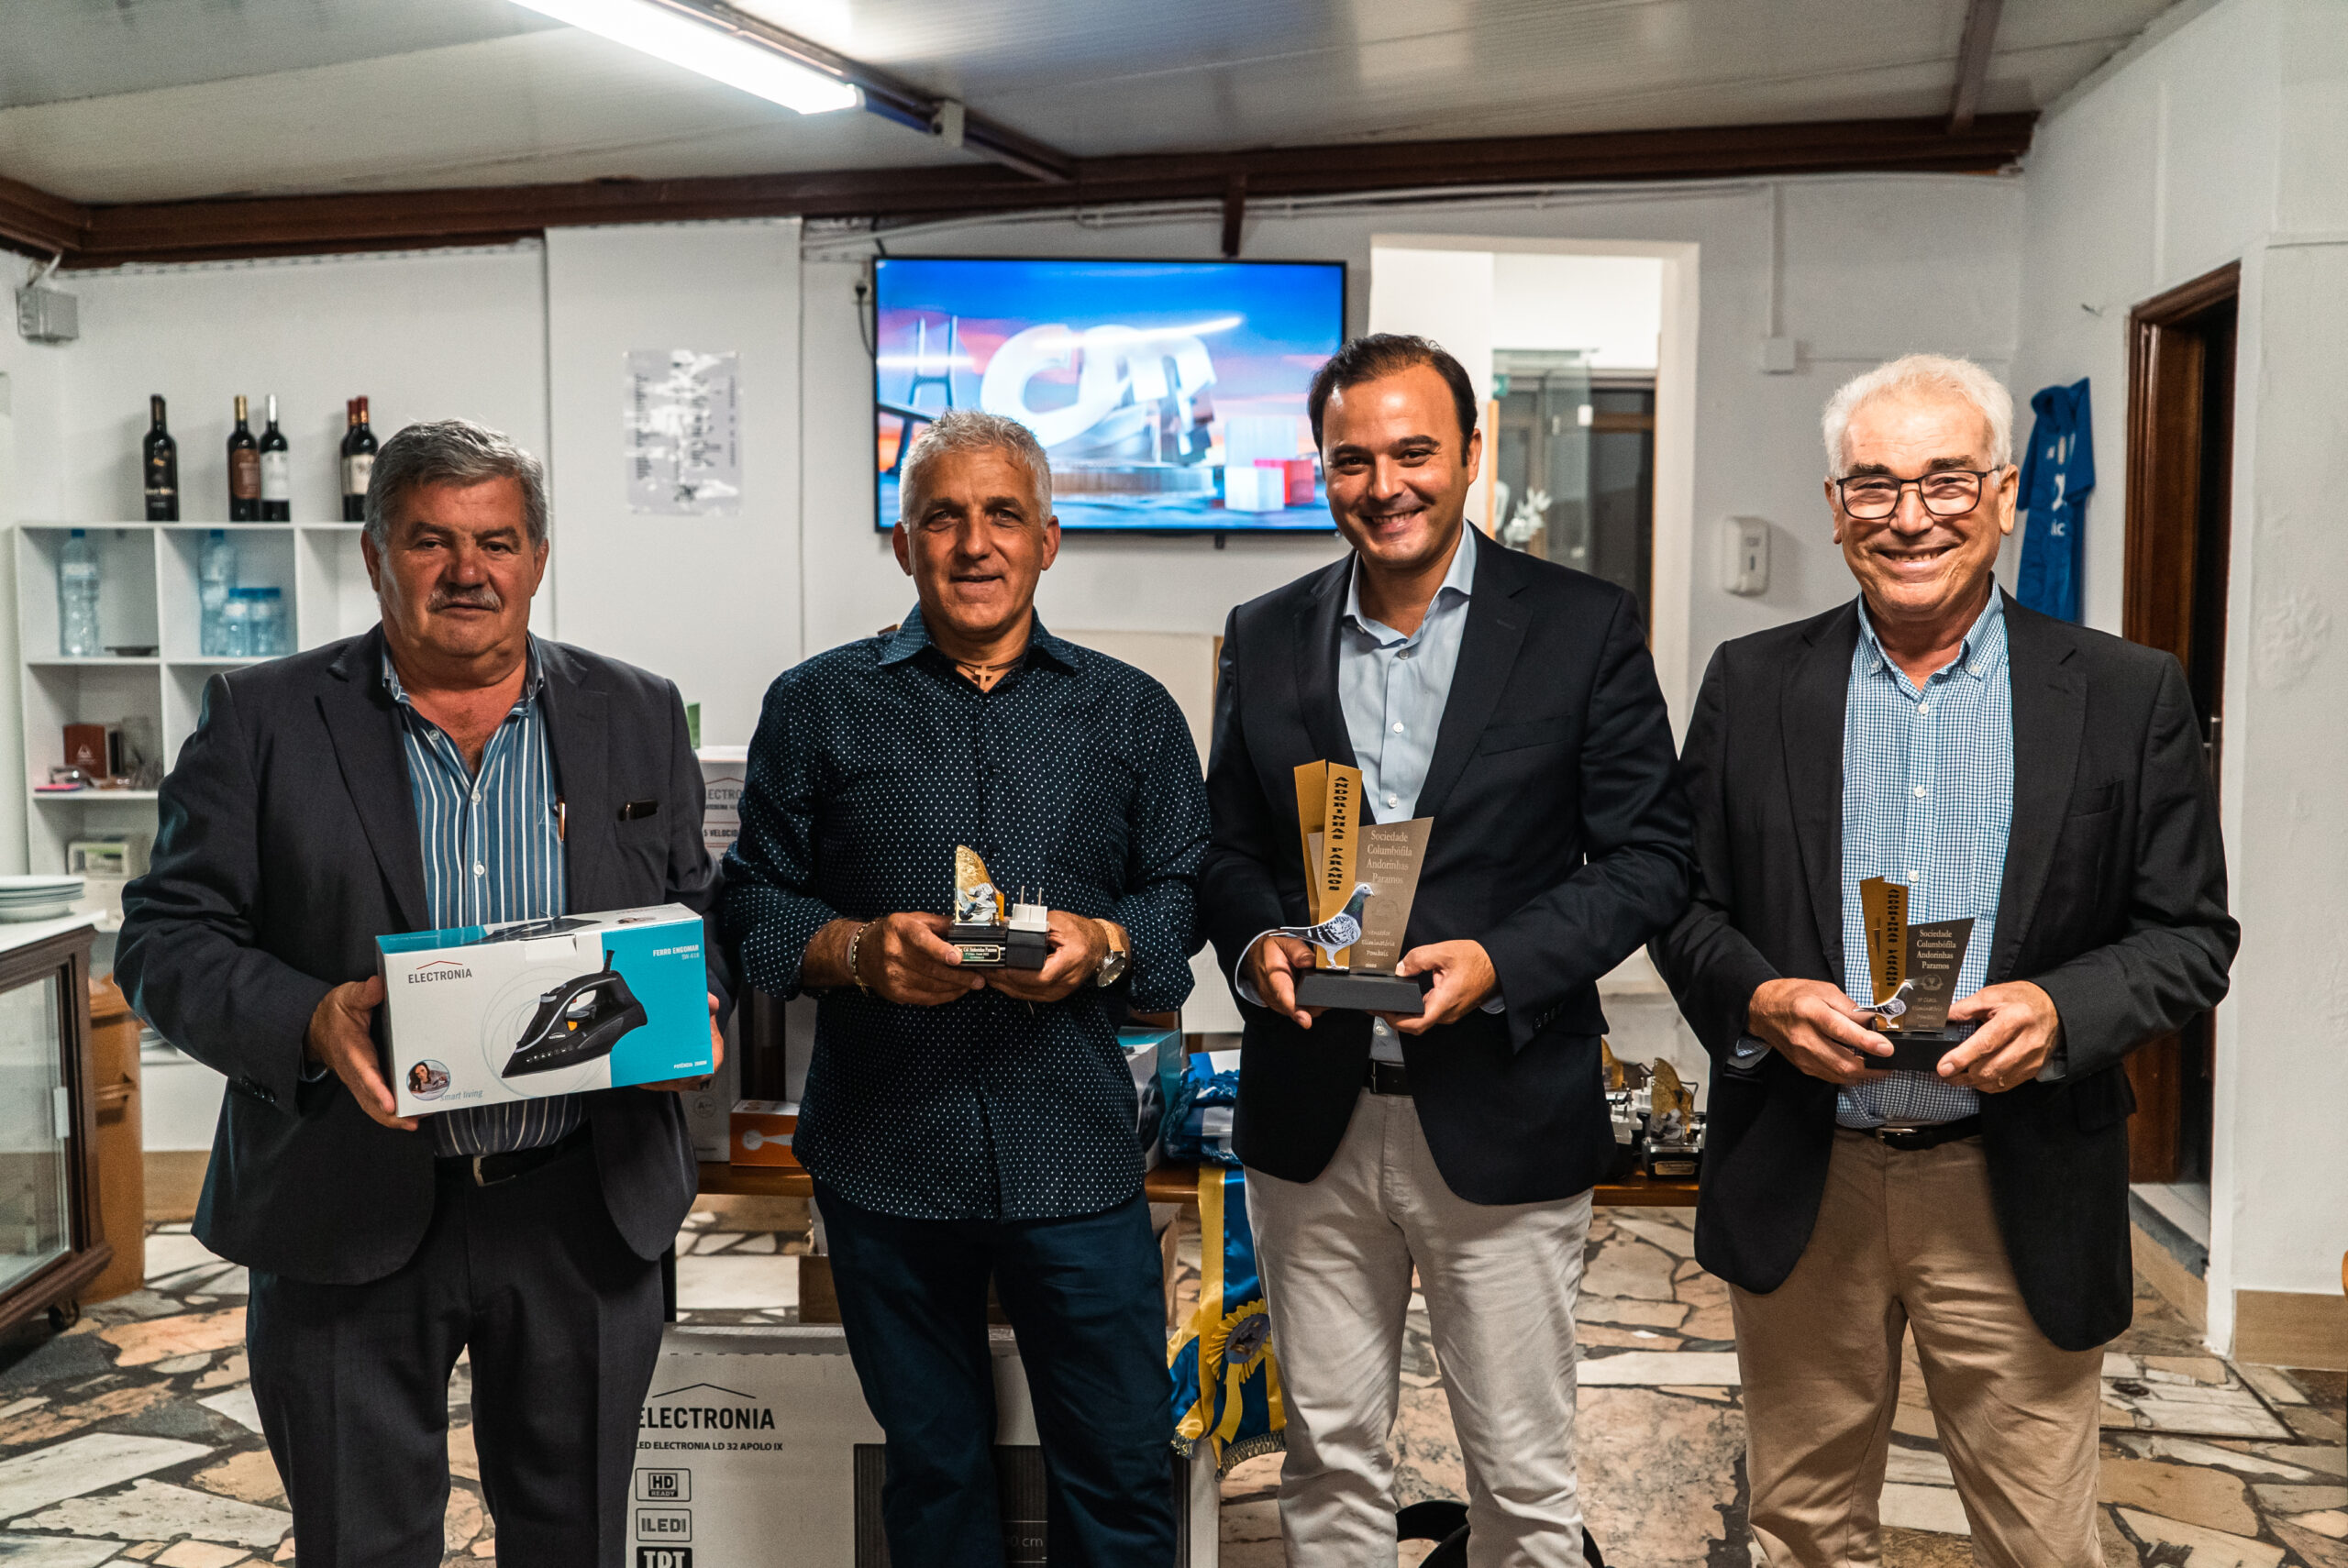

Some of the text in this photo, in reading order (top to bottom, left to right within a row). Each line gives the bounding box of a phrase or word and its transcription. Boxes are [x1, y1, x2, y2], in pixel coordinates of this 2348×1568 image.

[1327, 776, 1349, 891] ANDORINHAS PARAMOS
[1370, 829, 1409, 842] Sociedade
[1367, 844, 1412, 856] Columbófila
[1366, 857, 1409, 870] Andorinhas
[1372, 872, 1403, 884] Paramos
[1919, 929, 1953, 937] Sociedade
[1916, 939, 1956, 949] Columbófila
[652, 944, 700, 957] FERRO ENGOMAR
[1916, 950, 1954, 959] Andorinhas
[1922, 960, 1950, 969] Paramos
[408, 967, 472, 984] ELECTRONIA
[653, 1441, 711, 1451] ELECTRONIA
[713, 1442, 725, 1451] LD
[726, 1442, 738, 1451] 32
[740, 1442, 772, 1451] APOLO
[774, 1442, 783, 1451] IX
[652, 1475, 674, 1489] HD
[1022, 1537, 1044, 1548] cm
